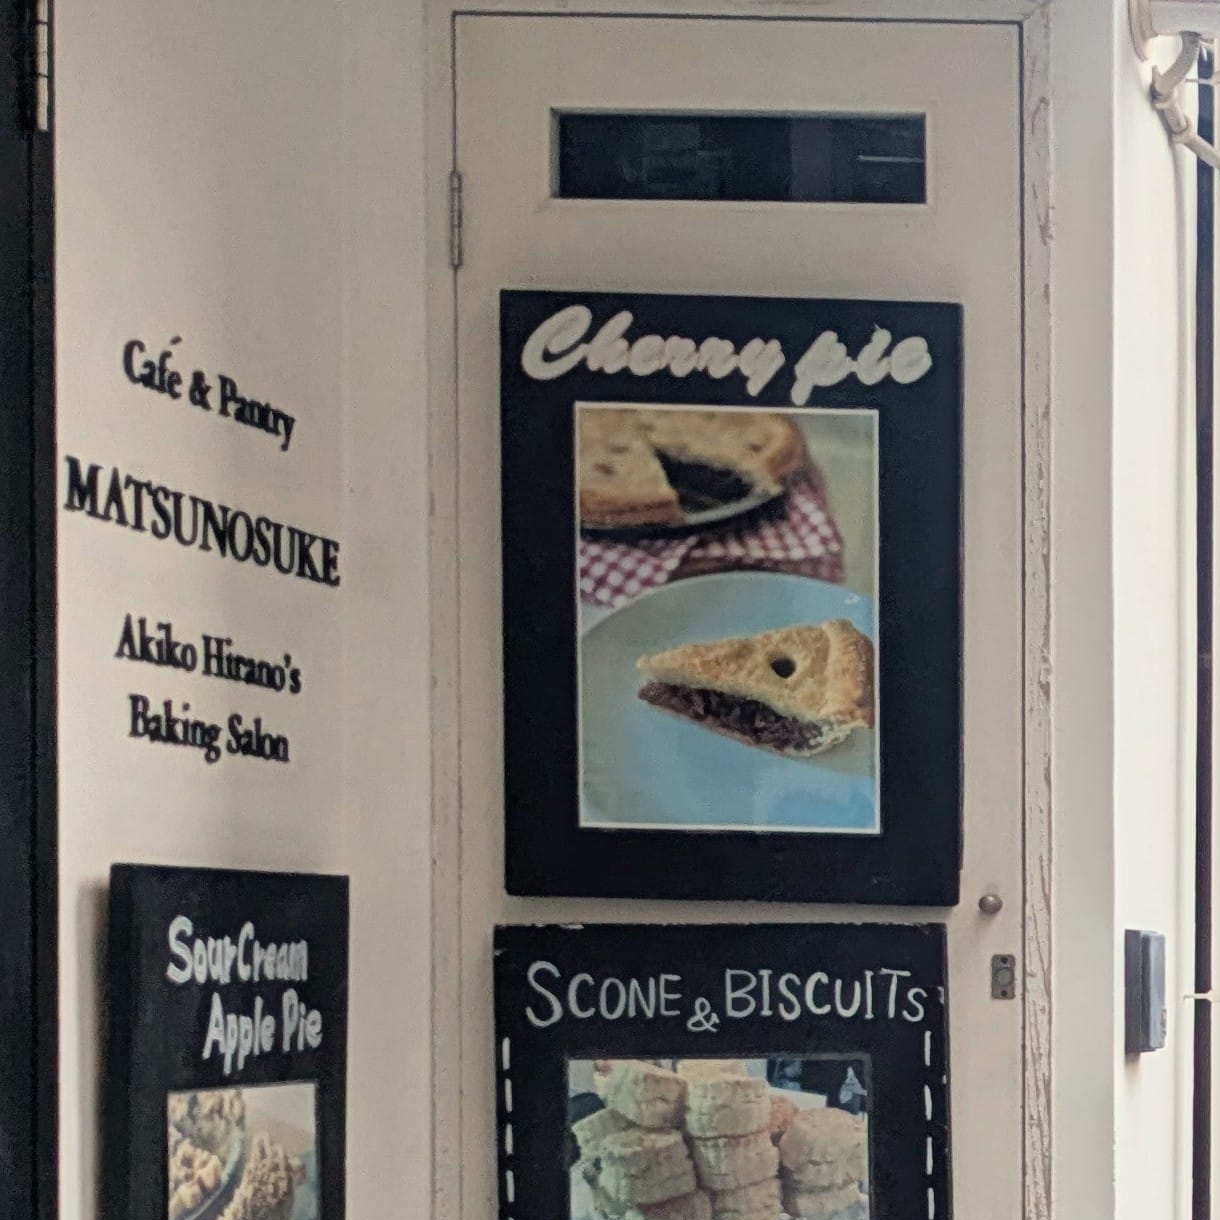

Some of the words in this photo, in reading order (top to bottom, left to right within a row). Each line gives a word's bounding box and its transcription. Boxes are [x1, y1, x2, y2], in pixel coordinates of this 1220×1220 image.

[123, 336, 182, 400] Café
[189, 371, 213, 410] &
[218, 374, 295, 451] Pantry
[63, 455, 341, 587] MATSUNOSUKE
[115, 613, 197, 672] Akiko
[201, 634, 302, 694] Hirano's
[128, 694, 222, 764] Baking
[226, 712, 291, 764] Salon
[167, 915, 237, 984] Sour
[237, 921, 308, 983] Cream
[202, 991, 277, 1077] Apple
[281, 987, 323, 1053] Pie
[687, 998, 721, 1033] &
